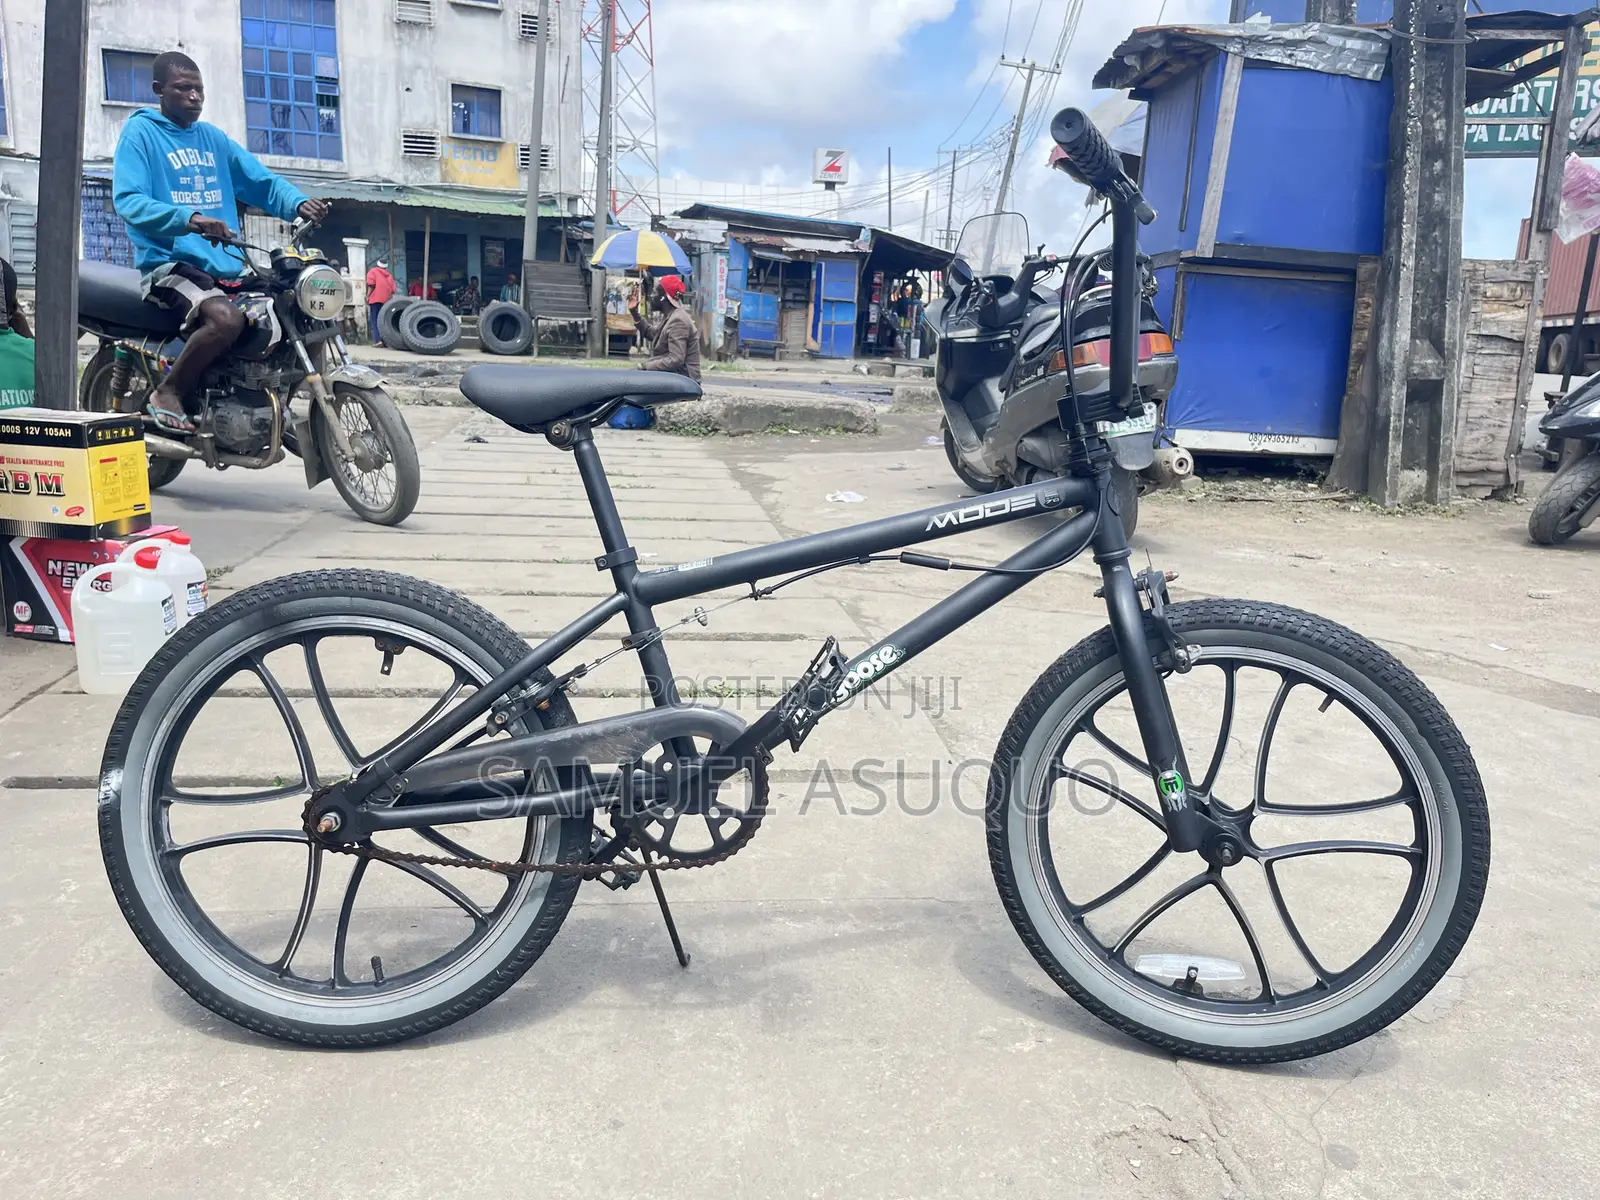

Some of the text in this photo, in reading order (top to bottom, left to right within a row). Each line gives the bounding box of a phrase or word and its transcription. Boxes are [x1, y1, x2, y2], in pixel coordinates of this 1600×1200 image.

[171, 190, 202, 204] HORSE
[0, 389, 34, 406] ATION
[0, 425, 72, 437] 000S 12V 105AH
[925, 493, 1036, 532] MODE
[15, 604, 30, 615] MF
